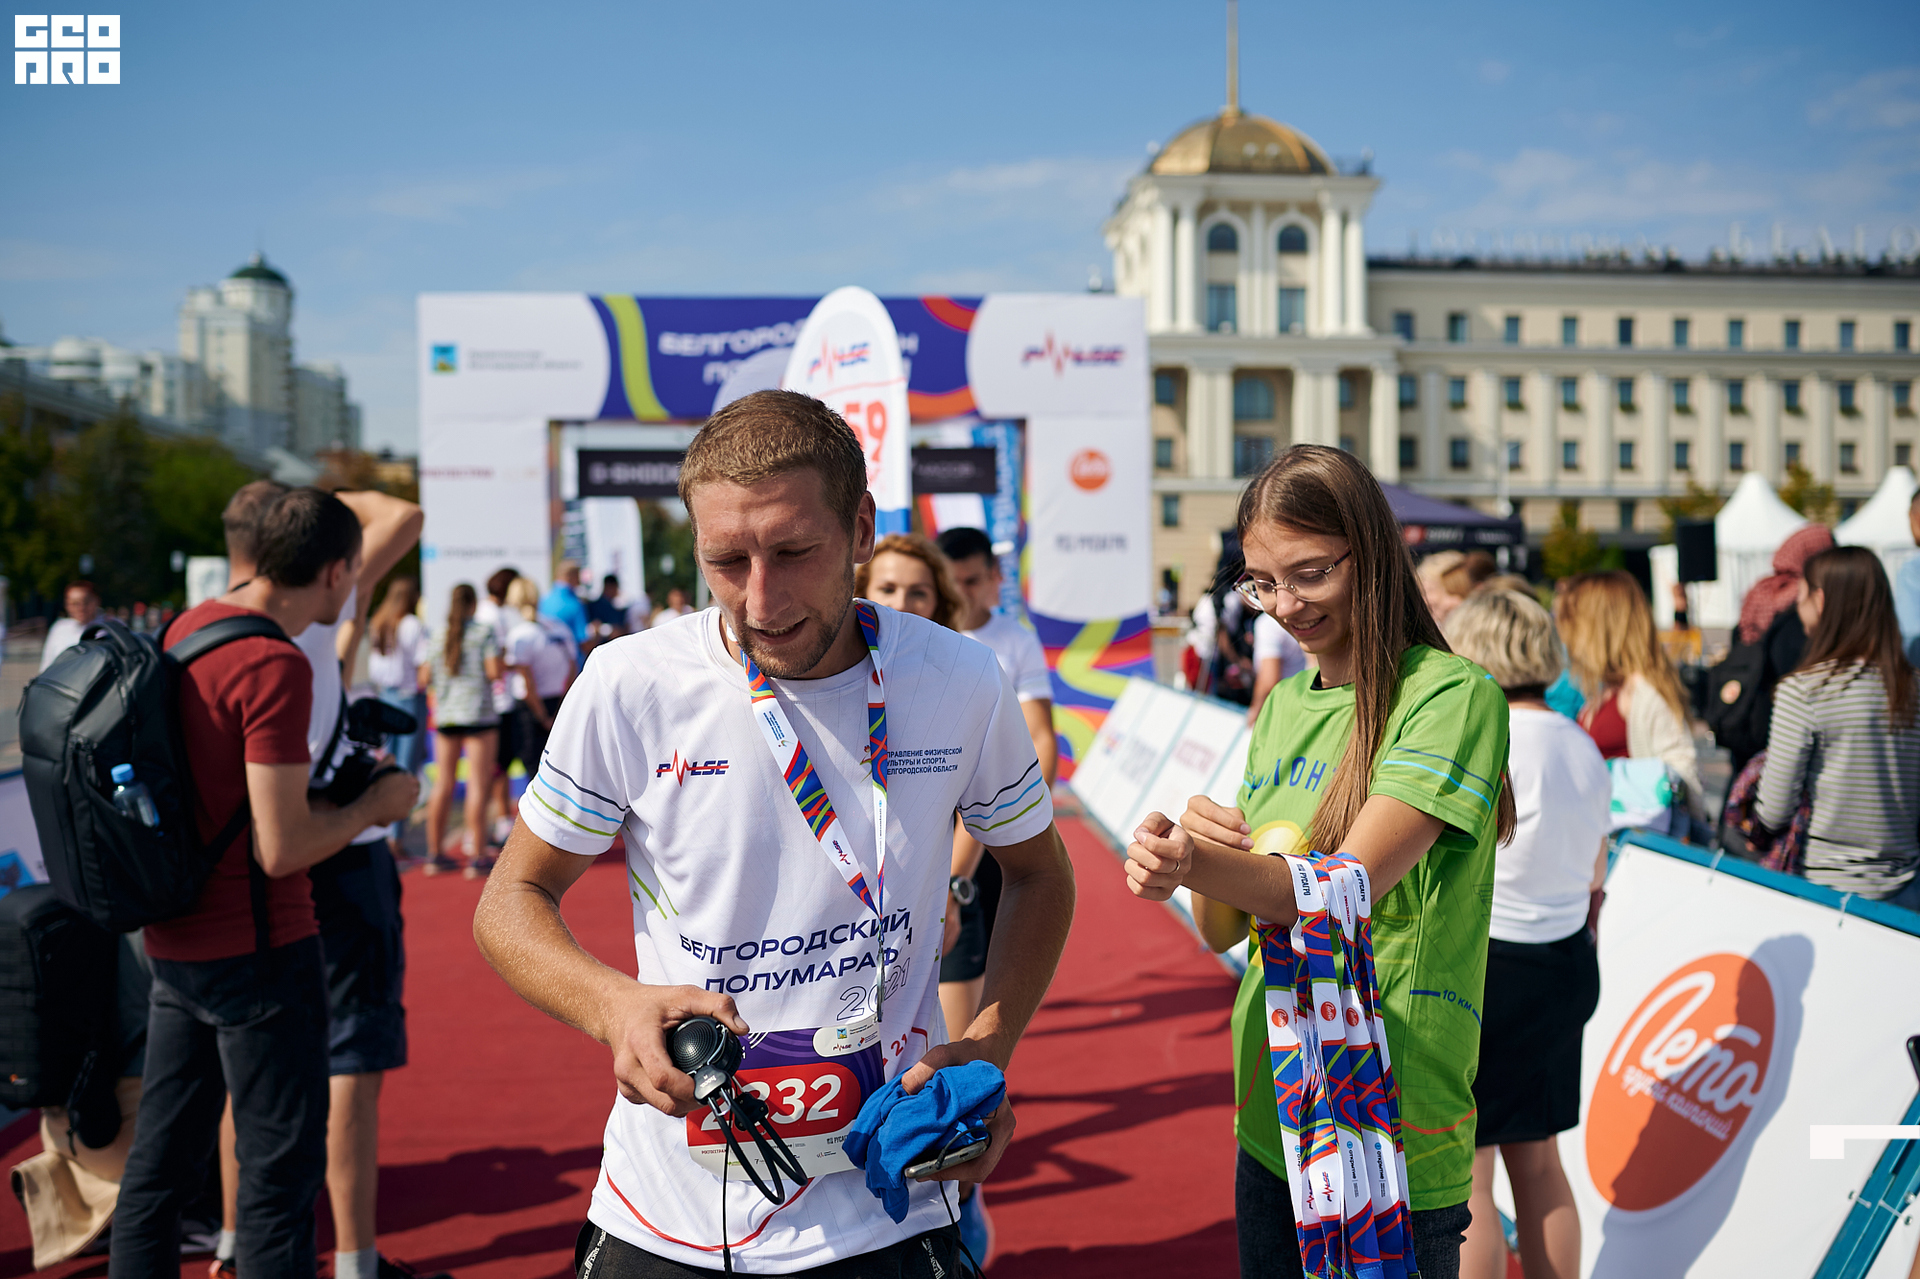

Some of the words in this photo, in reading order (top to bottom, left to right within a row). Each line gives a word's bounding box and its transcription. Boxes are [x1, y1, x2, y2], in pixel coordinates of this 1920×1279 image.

[887, 749, 923, 758] ПРАВЛЕНИЕ
[924, 746, 962, 756] ФИЗИЧЕСКОЙ
[887, 758, 916, 766] УЛЬТУРЫ
[922, 757, 946, 765] СПОРТА
[887, 765, 931, 775] ЕЛГОРОДСКОЙ
[933, 764, 958, 773] ОБЛАСТИ
[680, 908, 911, 965] БЕЛГОРОДСКИЙ
[1442, 989, 1457, 1002] 10
